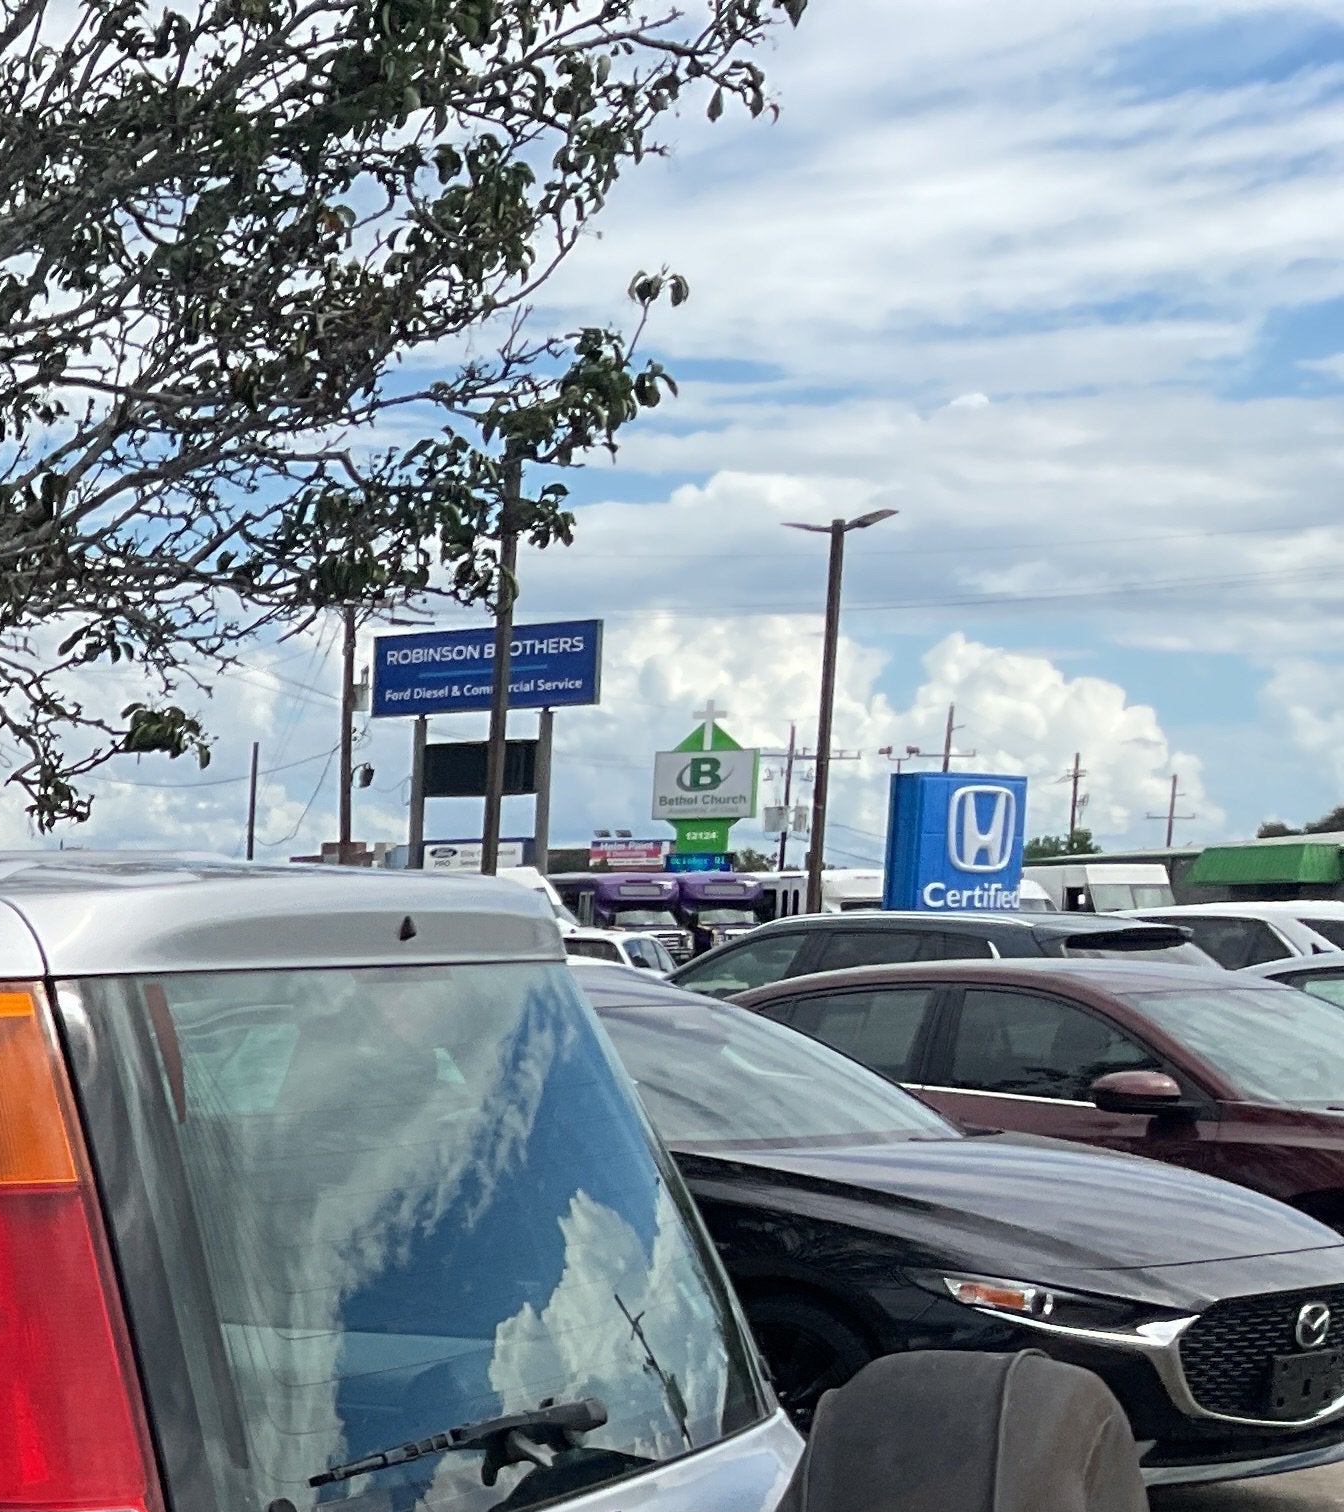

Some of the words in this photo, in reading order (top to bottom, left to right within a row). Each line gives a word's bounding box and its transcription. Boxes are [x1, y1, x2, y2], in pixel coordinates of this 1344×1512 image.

[386, 644, 480, 665] ROBINSON
[483, 636, 585, 659] BOTHERS
[385, 688, 411, 701] Ford
[413, 685, 449, 700] Diesel
[450, 685, 461, 697] &
[463, 679, 534, 697] Comrcial
[537, 677, 583, 691] Service
[658, 795, 698, 806] Bethel
[701, 793, 747, 805] Church
[923, 882, 1020, 909] Certified
